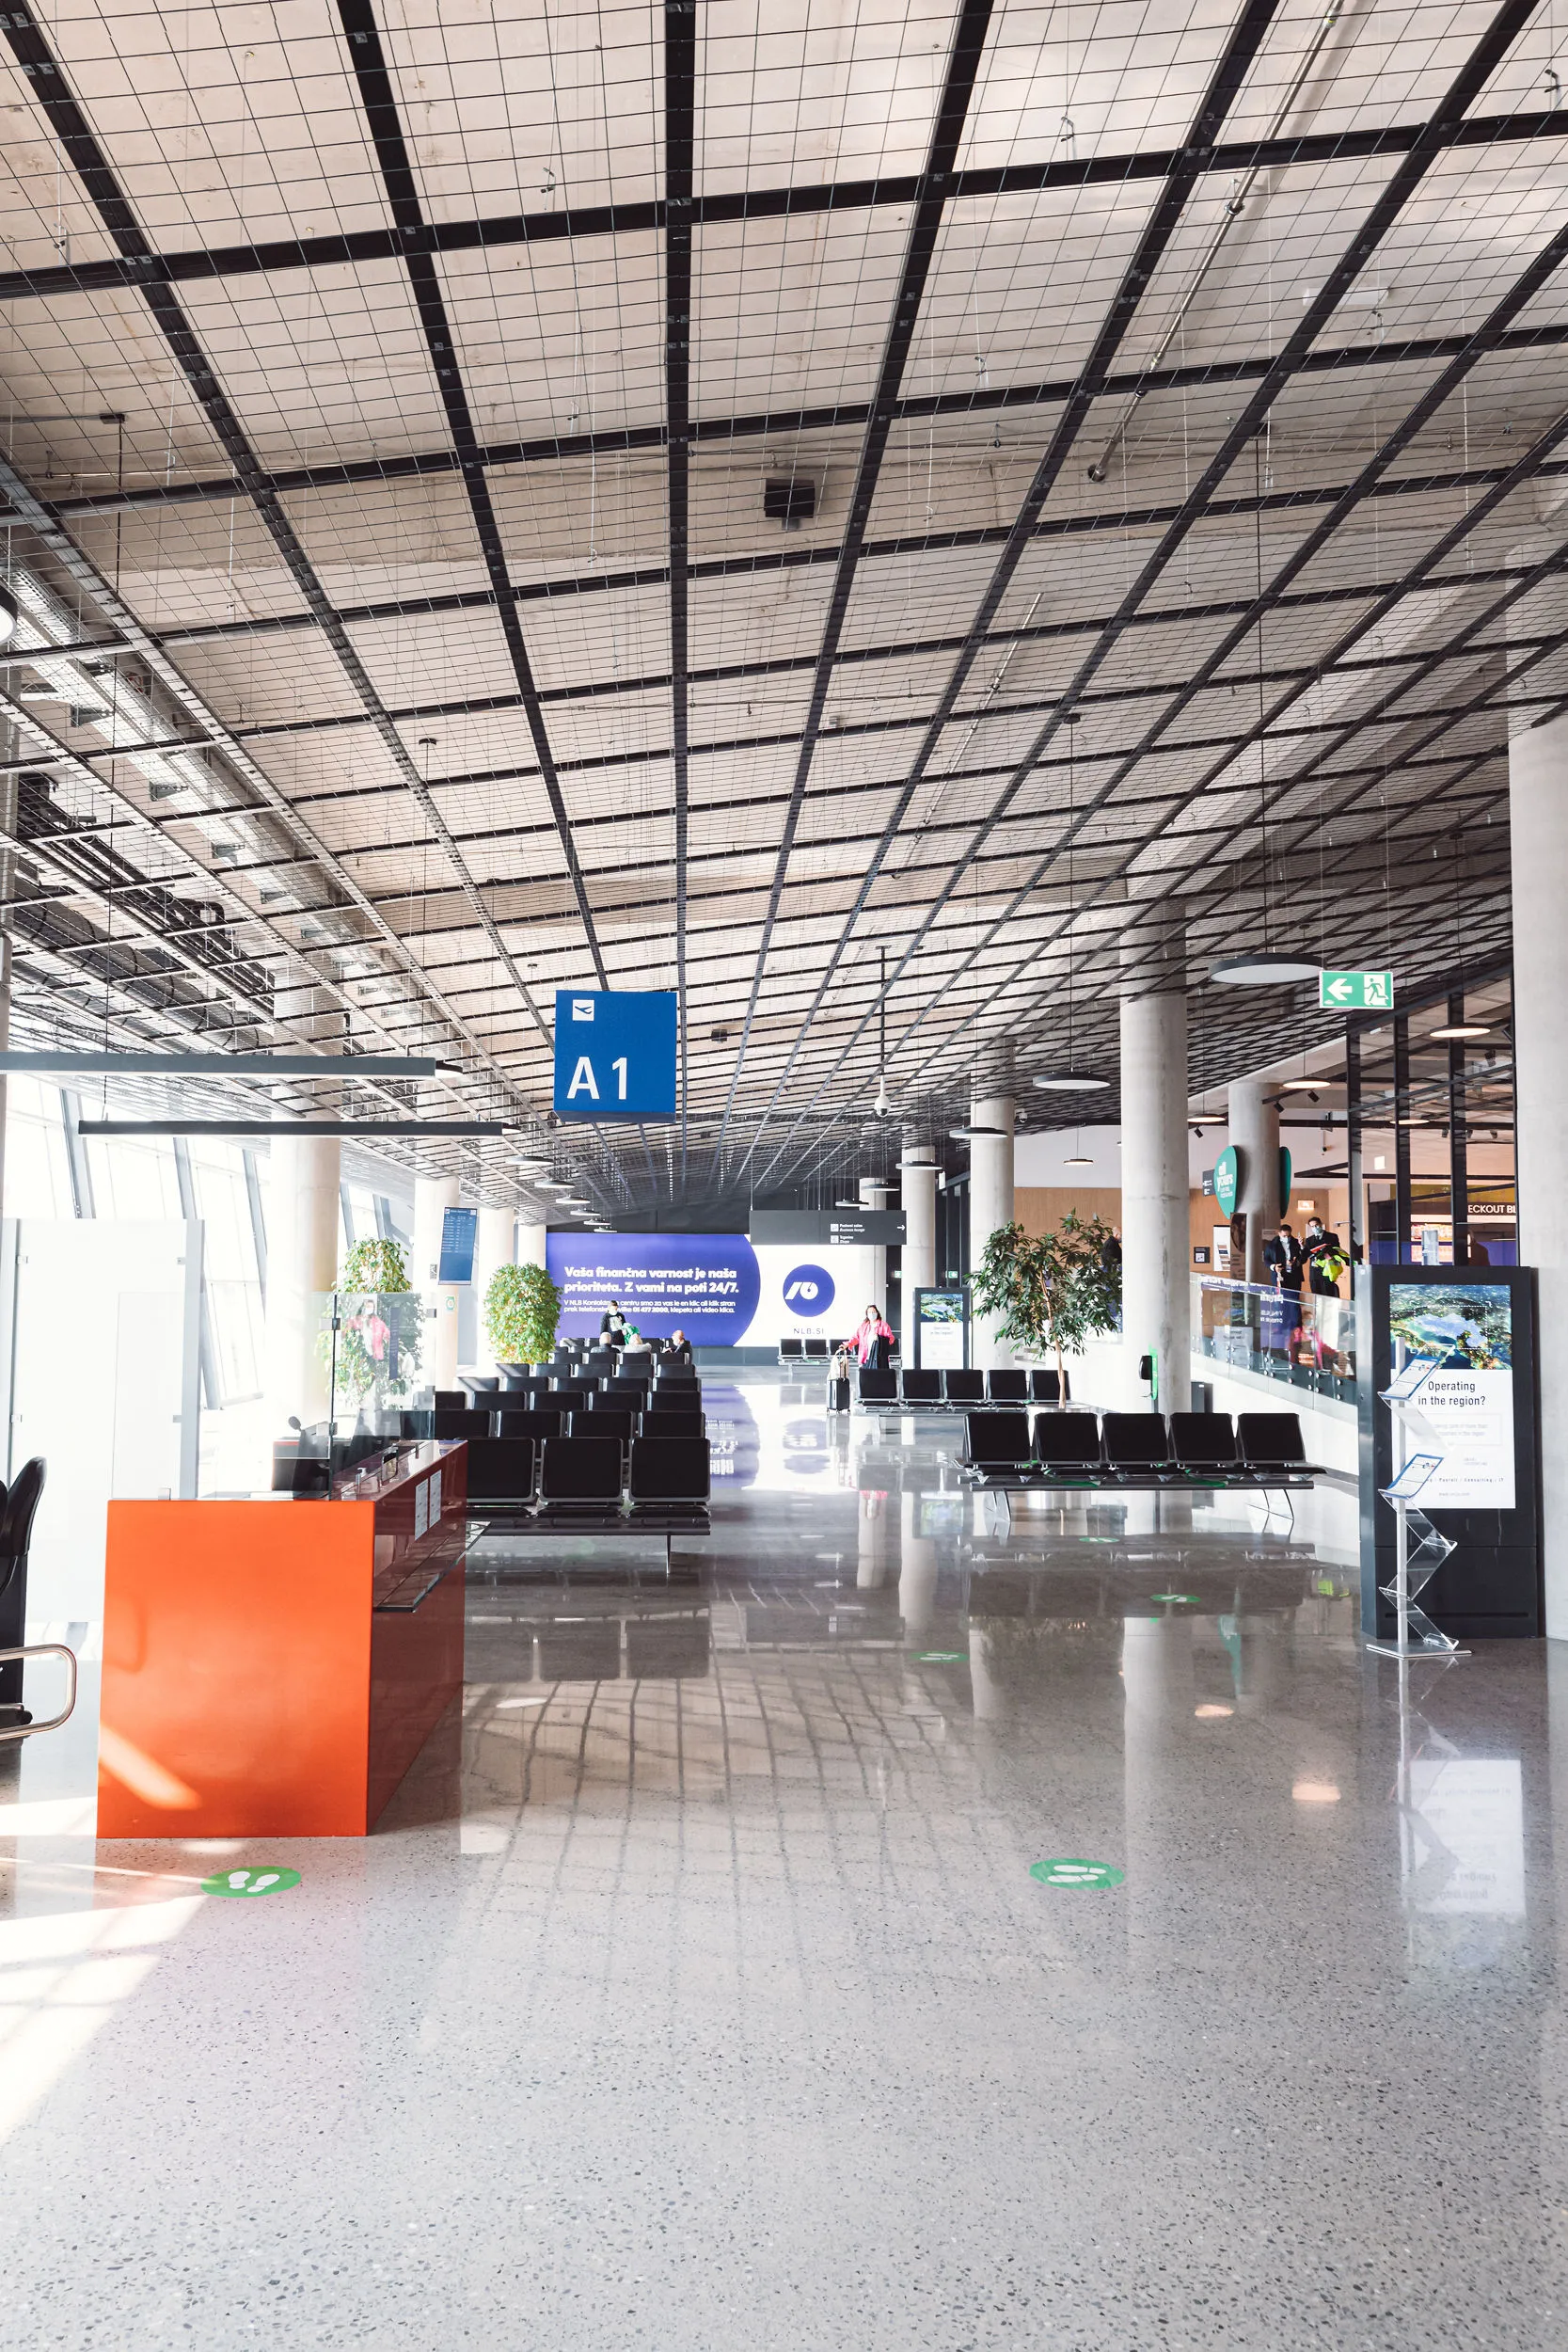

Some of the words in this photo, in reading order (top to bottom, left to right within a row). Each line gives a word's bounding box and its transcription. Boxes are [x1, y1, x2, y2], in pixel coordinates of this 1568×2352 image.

[566, 1056, 600, 1100] A
[611, 1057, 627, 1100] 1
[1467, 1204, 1505, 1214] ECKOUT
[564, 1266, 594, 1278] Vaša
[595, 1266, 647, 1279] finančna
[649, 1268, 694, 1279] varnost
[694, 1267, 706, 1280] je
[708, 1267, 737, 1279] naša
[564, 1280, 623, 1294] prioriteta.
[624, 1281, 634, 1293] Z
[635, 1281, 665, 1293] vami
[667, 1284, 682, 1293] na
[684, 1281, 707, 1295] poti
[708, 1281, 739, 1295] 24/7.
[1428, 1380, 1476, 1392] Operating
[1418, 1396, 1427, 1406] in
[1430, 1396, 1446, 1406] the
[1449, 1396, 1486, 1407] region?
